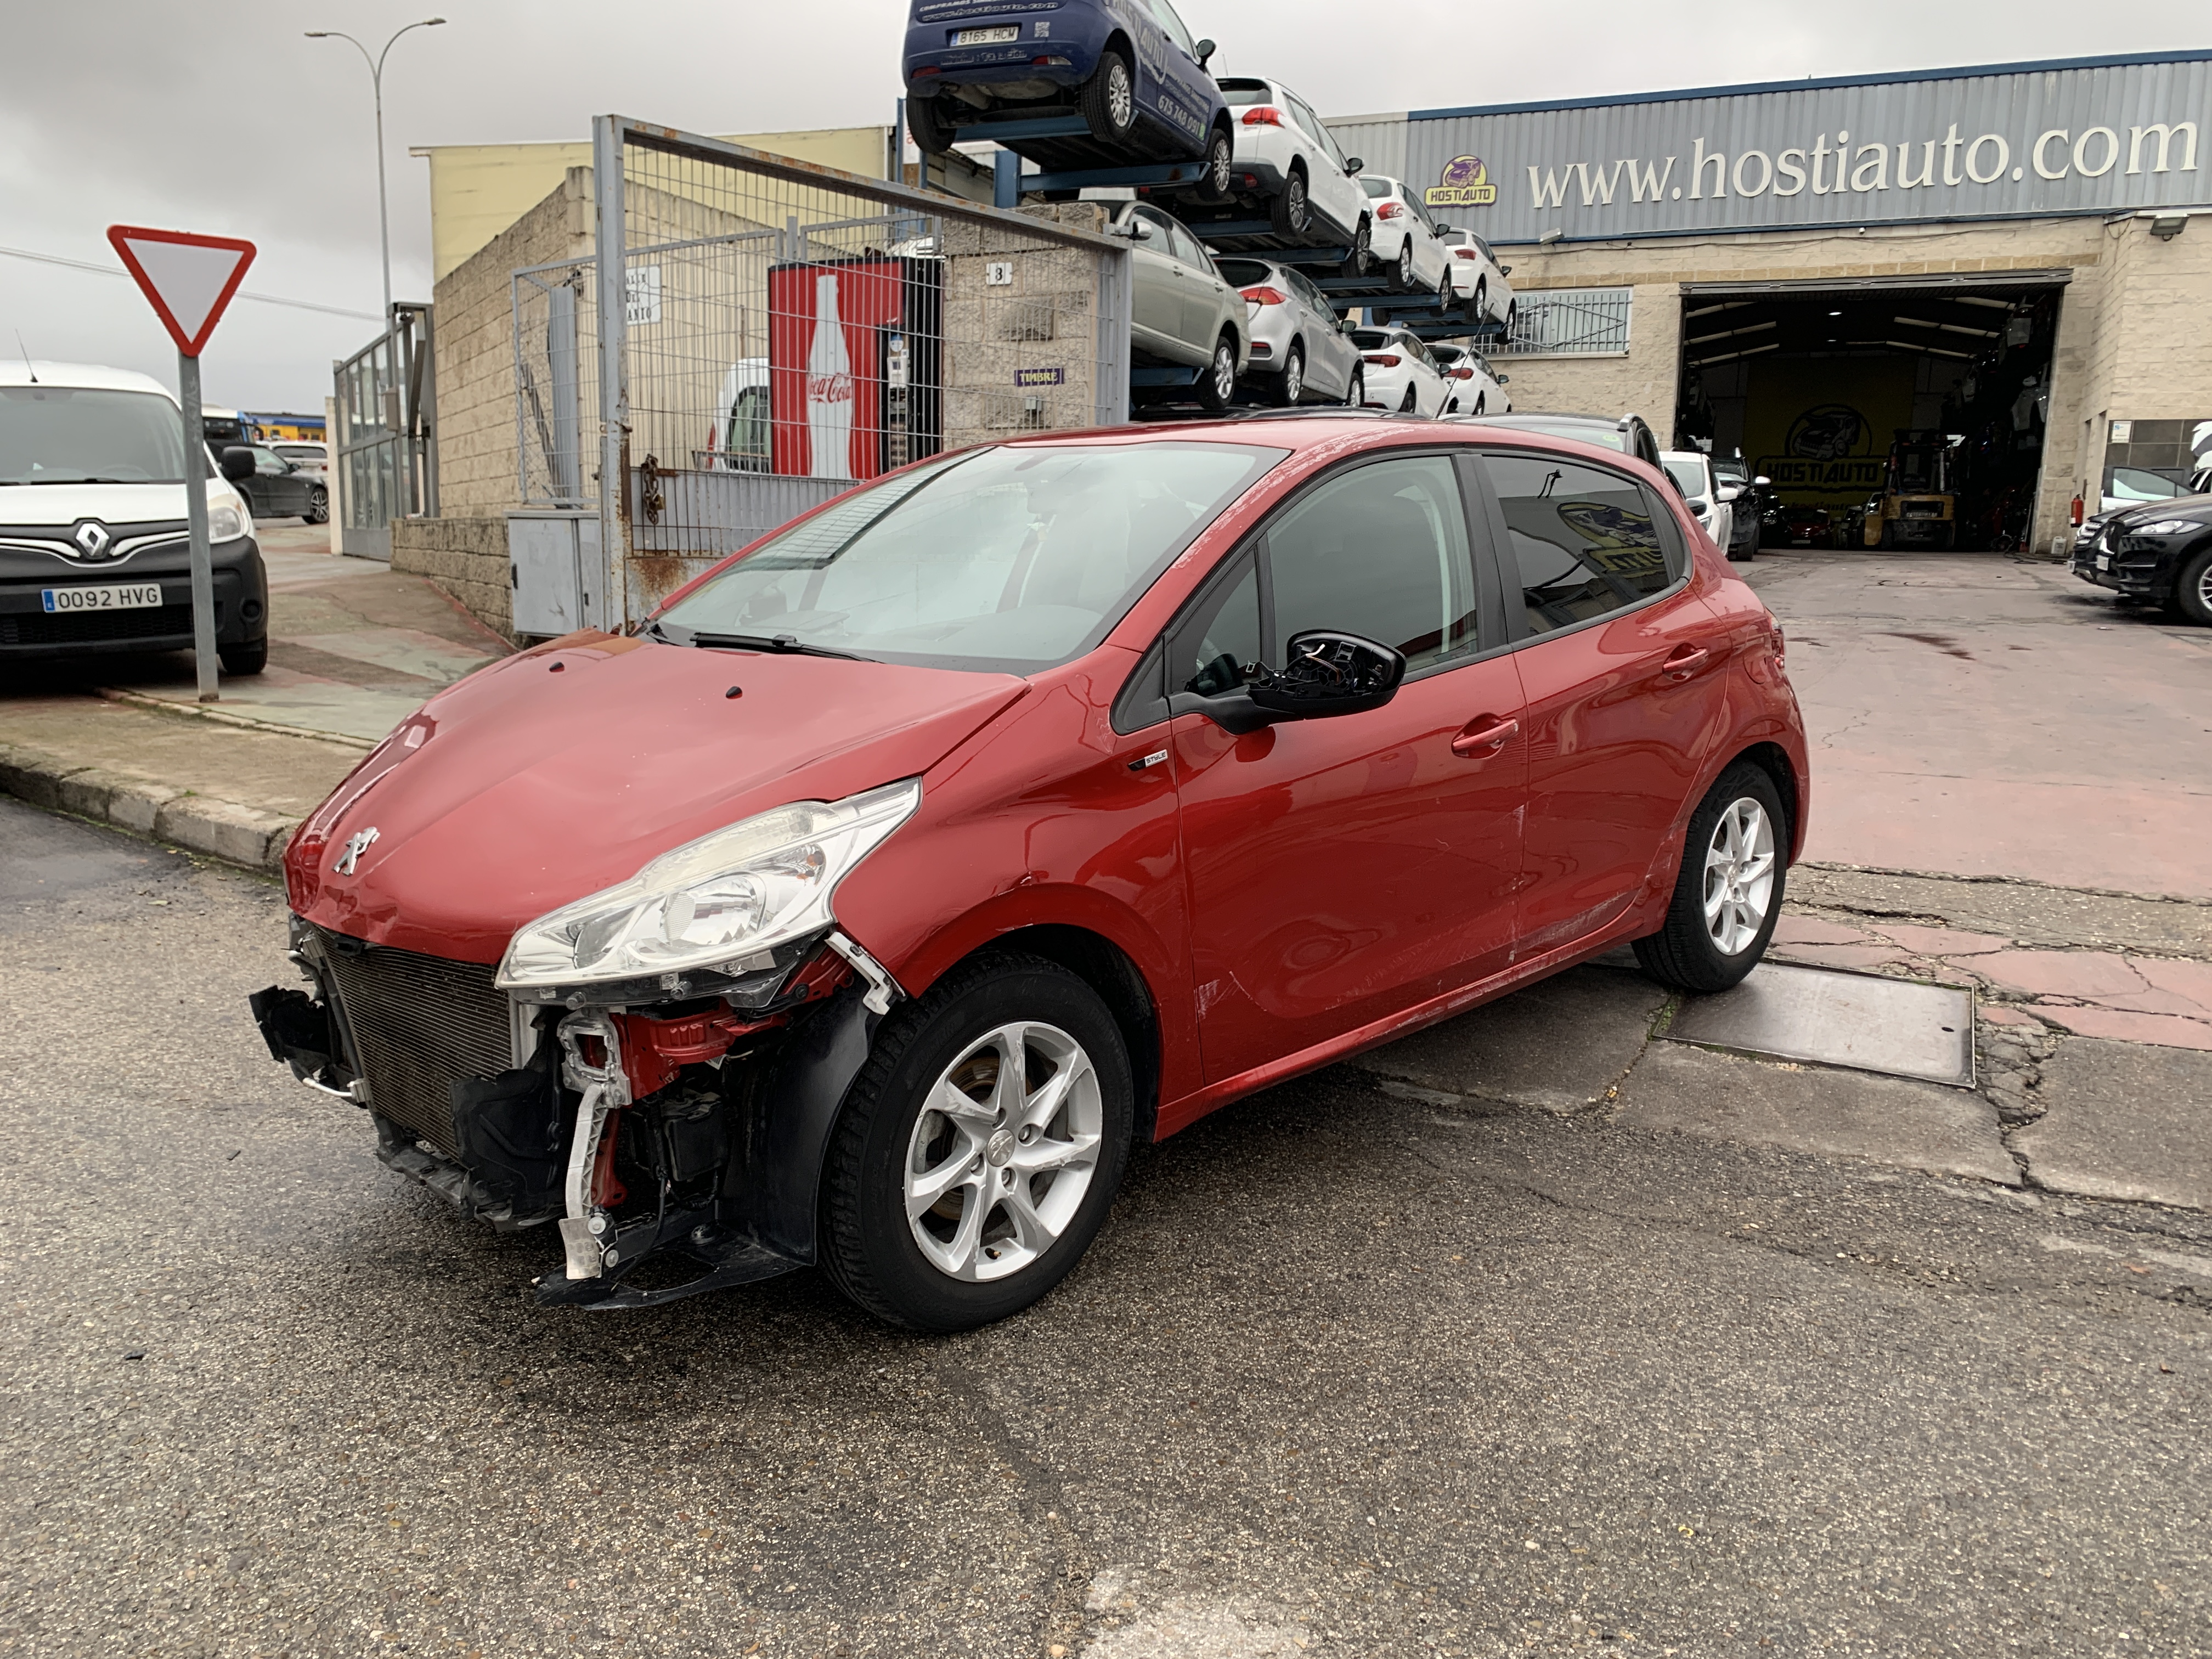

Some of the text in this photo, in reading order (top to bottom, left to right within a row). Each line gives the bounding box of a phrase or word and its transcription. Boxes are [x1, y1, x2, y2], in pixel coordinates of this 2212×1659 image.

[960, 30, 987, 43] 8165
[1158, 94, 1174, 116] 675
[1174, 105, 1188, 129] 748
[1187, 116, 1200, 136] 091
[1526, 121, 2199, 210] www.hostiauto.com
[1430, 188, 1491, 202] HOSTIAUTO
[1019, 372, 1058, 382] TIMBRE
[808, 373, 852, 404] Coca-Cola
[1767, 462, 1878, 484] HOSTIAUTO
[58, 588, 158, 608] 0092 HVG
[1146, 752, 1166, 764] STYLE
